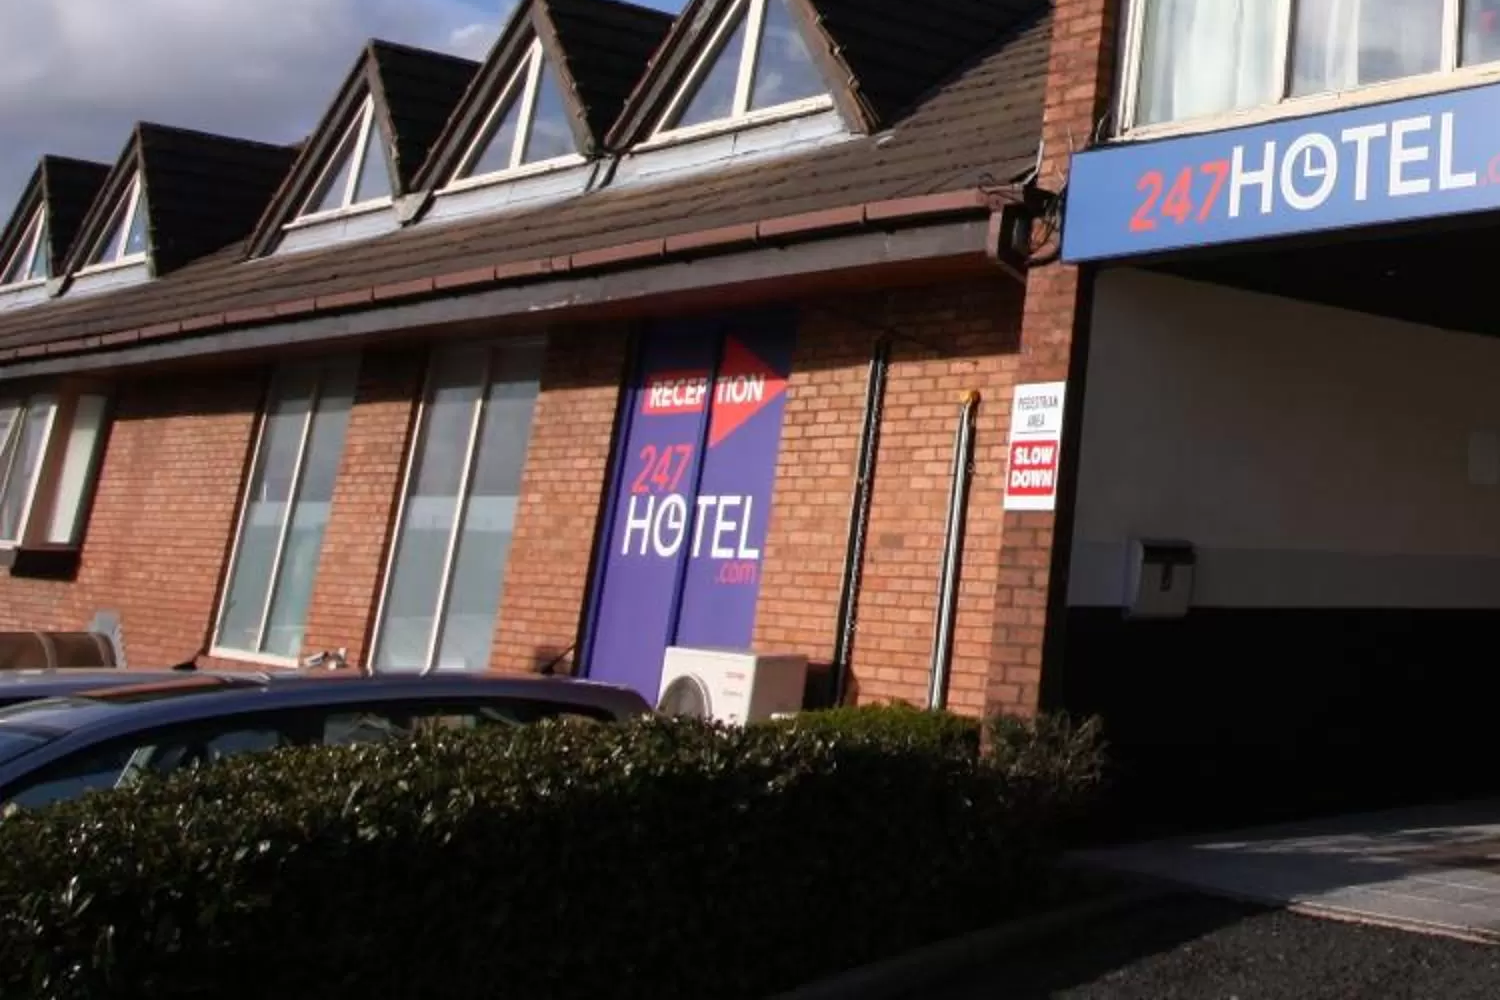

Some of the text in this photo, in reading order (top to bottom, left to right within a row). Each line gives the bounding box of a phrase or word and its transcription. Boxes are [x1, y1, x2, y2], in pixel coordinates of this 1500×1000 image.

[649, 373, 765, 408] RECEPTION
[631, 444, 692, 493] 247
[1014, 446, 1054, 465] SLOW
[1011, 469, 1053, 488] DOWN
[621, 493, 761, 560] HOTEL
[714, 561, 757, 585] .com
